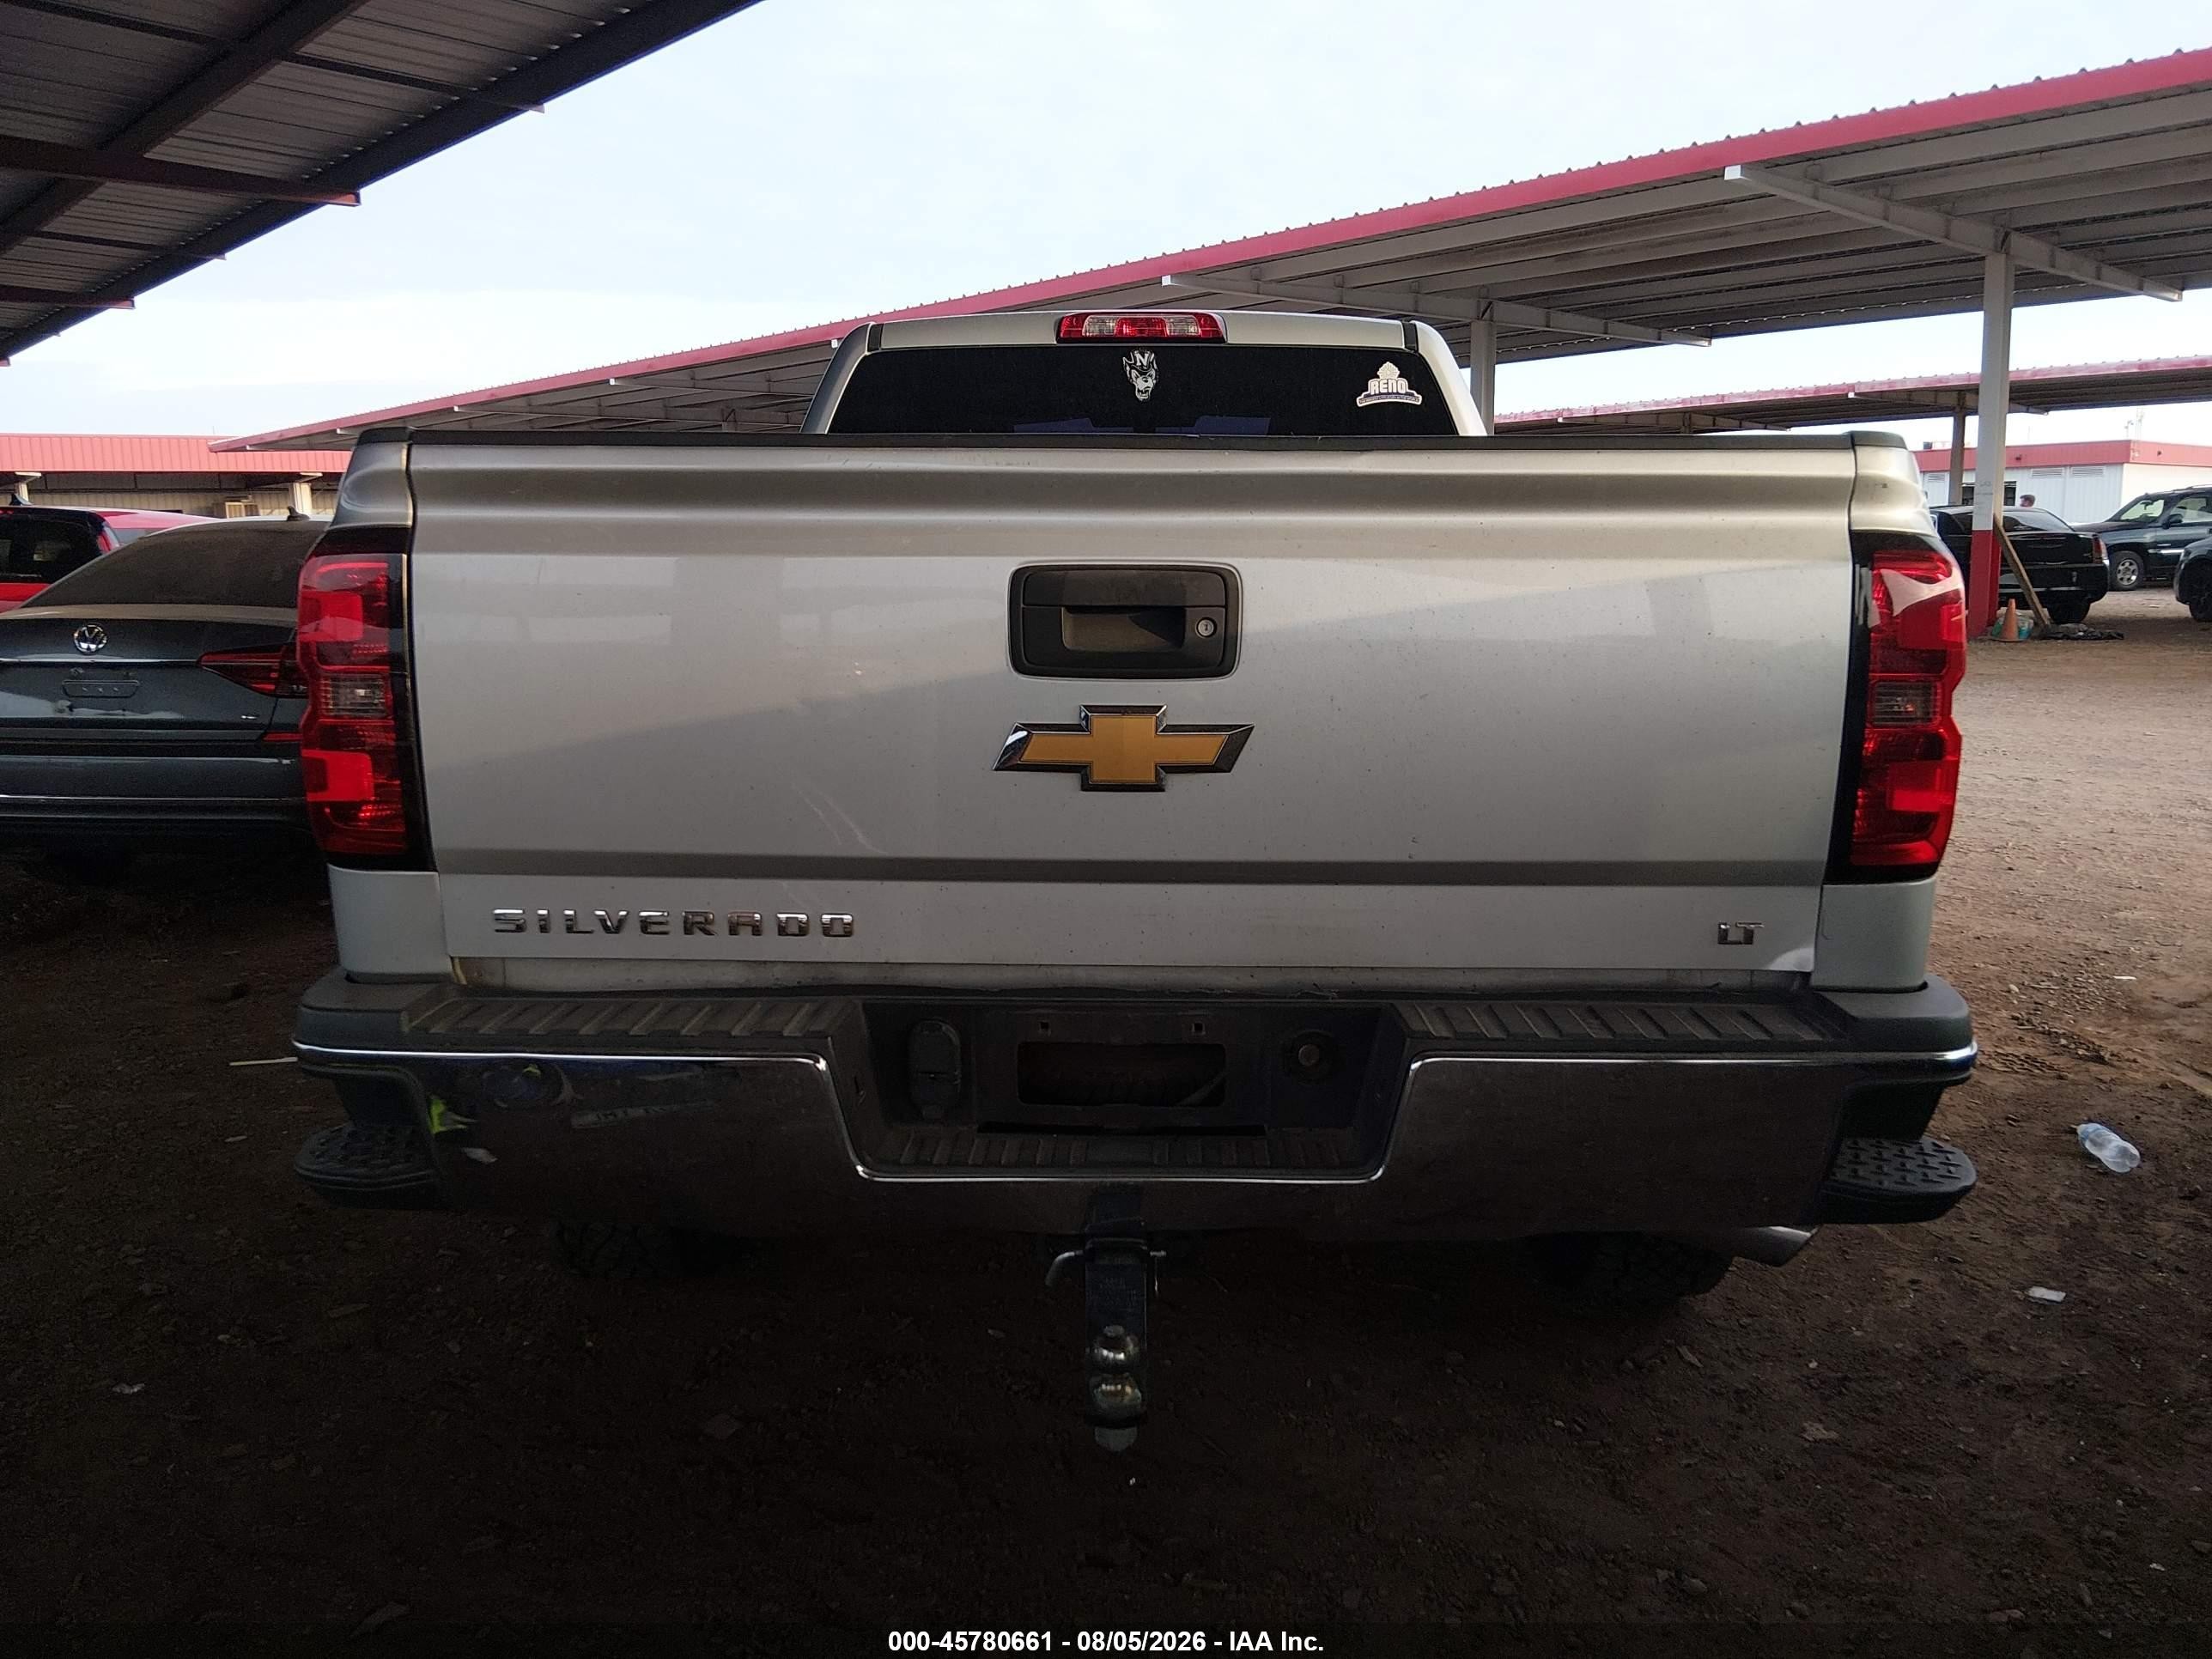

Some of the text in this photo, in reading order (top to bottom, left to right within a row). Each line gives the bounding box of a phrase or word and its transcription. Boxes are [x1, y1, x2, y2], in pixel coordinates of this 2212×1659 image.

[1134, 352, 1149, 367] N
[1370, 379, 1407, 395] RENO
[492, 908, 854, 938] SILVERADO
[1717, 922, 1764, 945] LT
